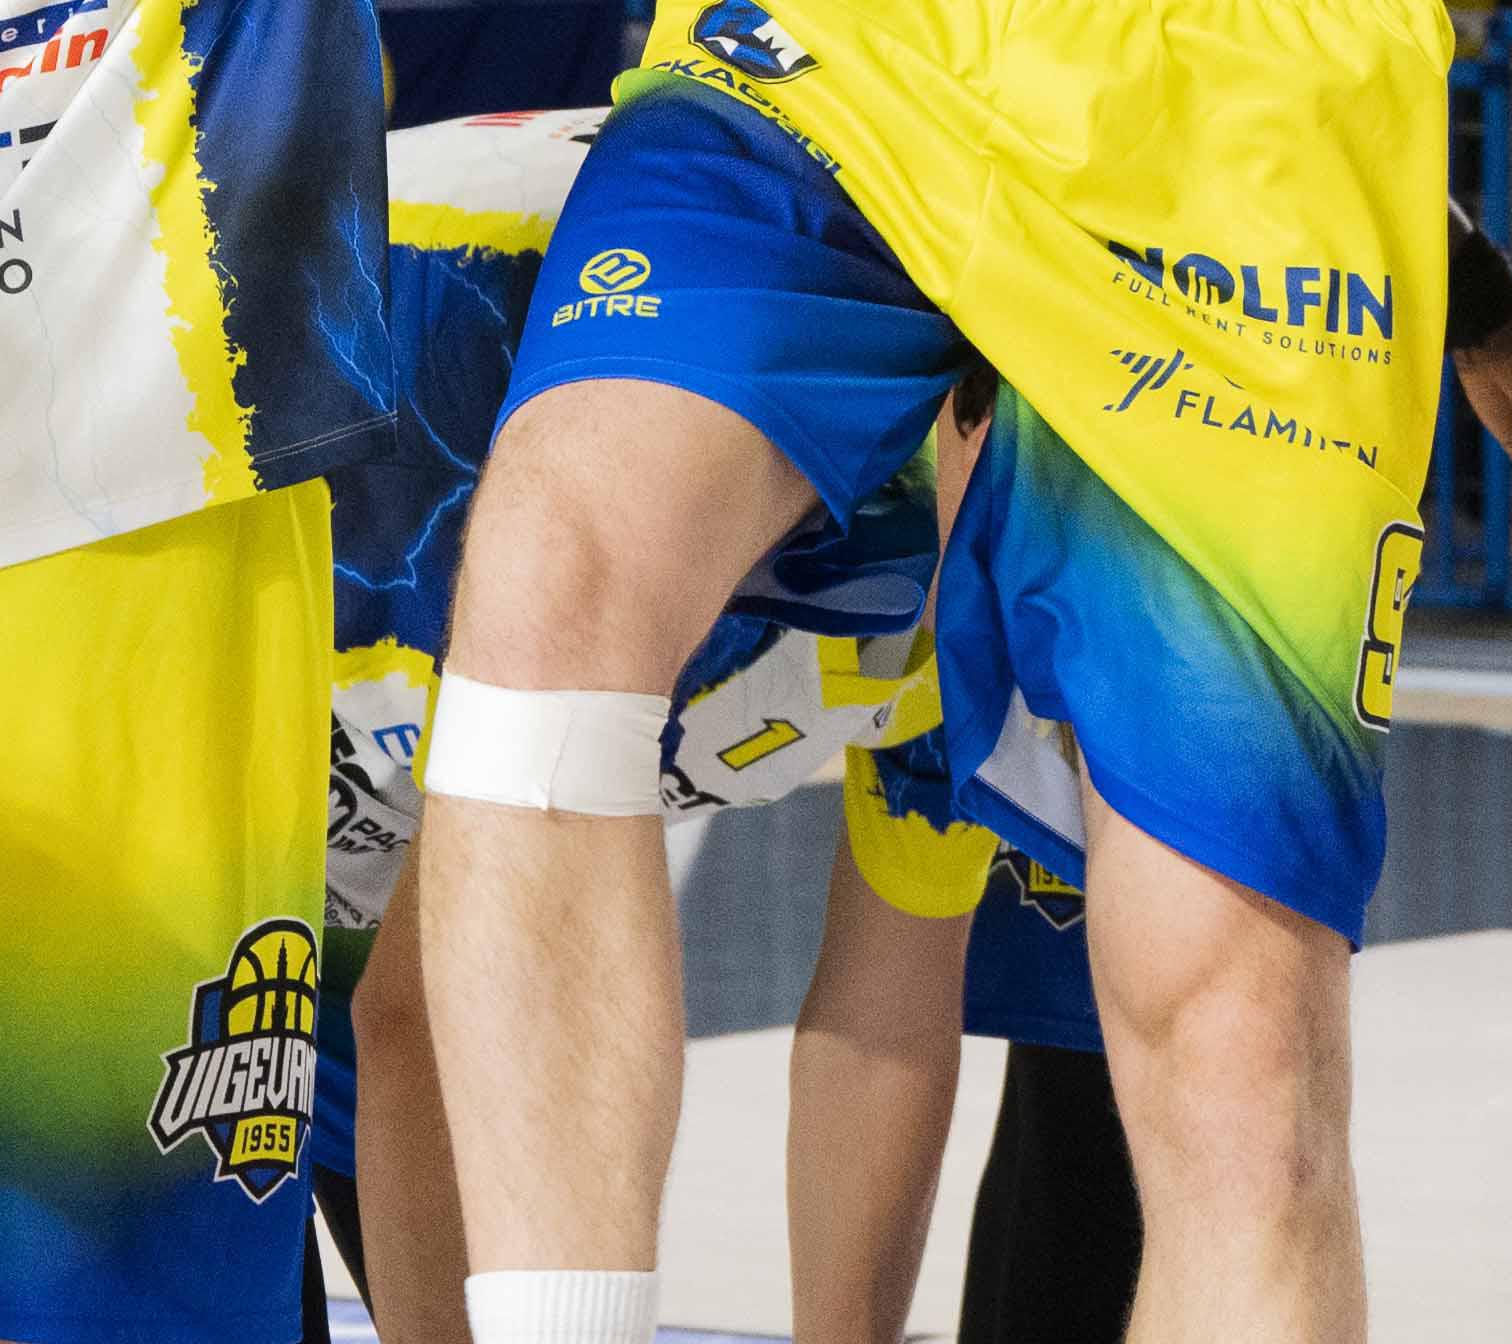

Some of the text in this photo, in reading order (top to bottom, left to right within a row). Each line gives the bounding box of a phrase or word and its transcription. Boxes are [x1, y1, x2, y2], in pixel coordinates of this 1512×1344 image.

[552, 295, 662, 327] BITRE
[1113, 271, 1171, 307] FULL
[1262, 330, 1393, 365] SOLUTIONS
[716, 718, 806, 772] 1
[160, 1036, 318, 1132] VIGEVAN
[239, 1122, 290, 1154] 1955
